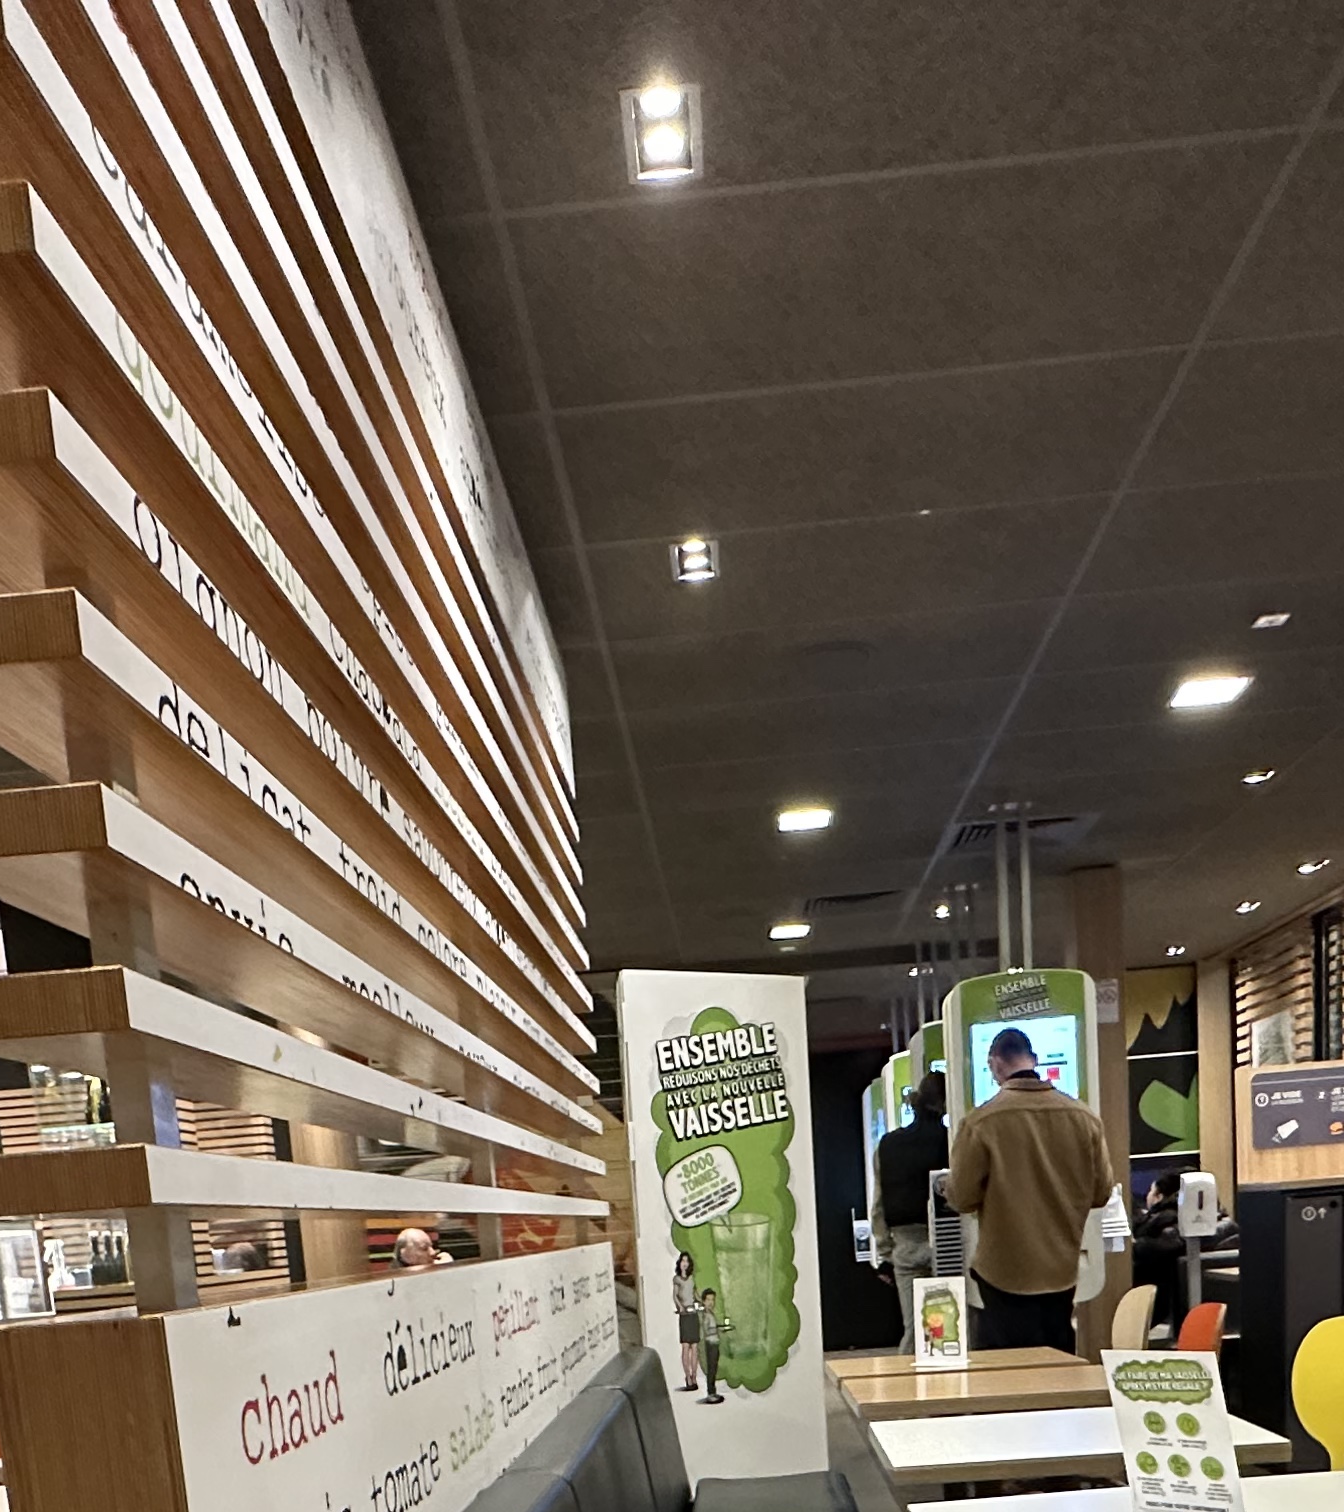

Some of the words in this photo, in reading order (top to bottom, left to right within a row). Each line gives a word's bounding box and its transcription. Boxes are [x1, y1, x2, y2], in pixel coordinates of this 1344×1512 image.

[995, 975, 1047, 996] ENSEMBLE
[999, 998, 1050, 1019] VAISSELLE
[657, 1022, 778, 1072] ENSEMBLE
[667, 1090, 698, 1108] AVEC
[702, 1086, 719, 1102] LA
[722, 1074, 785, 1098] NOUVELLE
[720, 1065, 741, 1081] NOS
[668, 1090, 789, 1141] VAISSELLE
[240, 1349, 345, 1466] chaud
[382, 1313, 476, 1397] délicieux
[449, 1393, 496, 1472] salade
[499, 1364, 535, 1428] tendre
